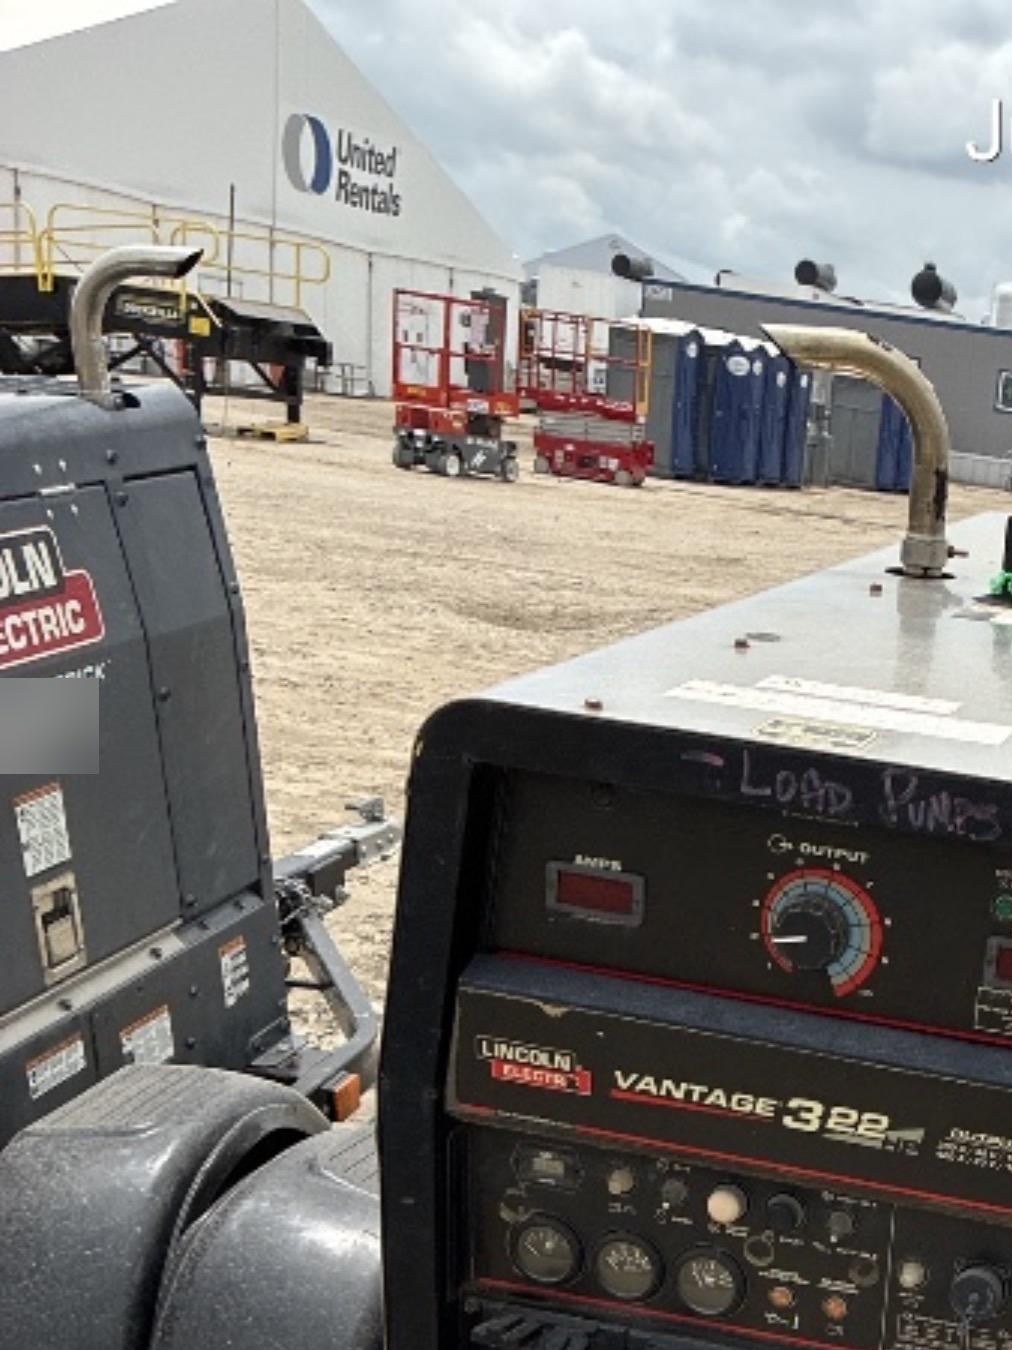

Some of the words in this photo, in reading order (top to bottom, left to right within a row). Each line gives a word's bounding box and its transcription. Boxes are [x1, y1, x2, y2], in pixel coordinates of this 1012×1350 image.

[337, 128, 397, 178] United
[336, 168, 402, 217] Rentals
[799, 841, 870, 865] OUTPUT
[481, 1040, 571, 1072] LINCOLN
[614, 1069, 778, 1117] VANTAGE
[782, 1097, 890, 1141] 322
